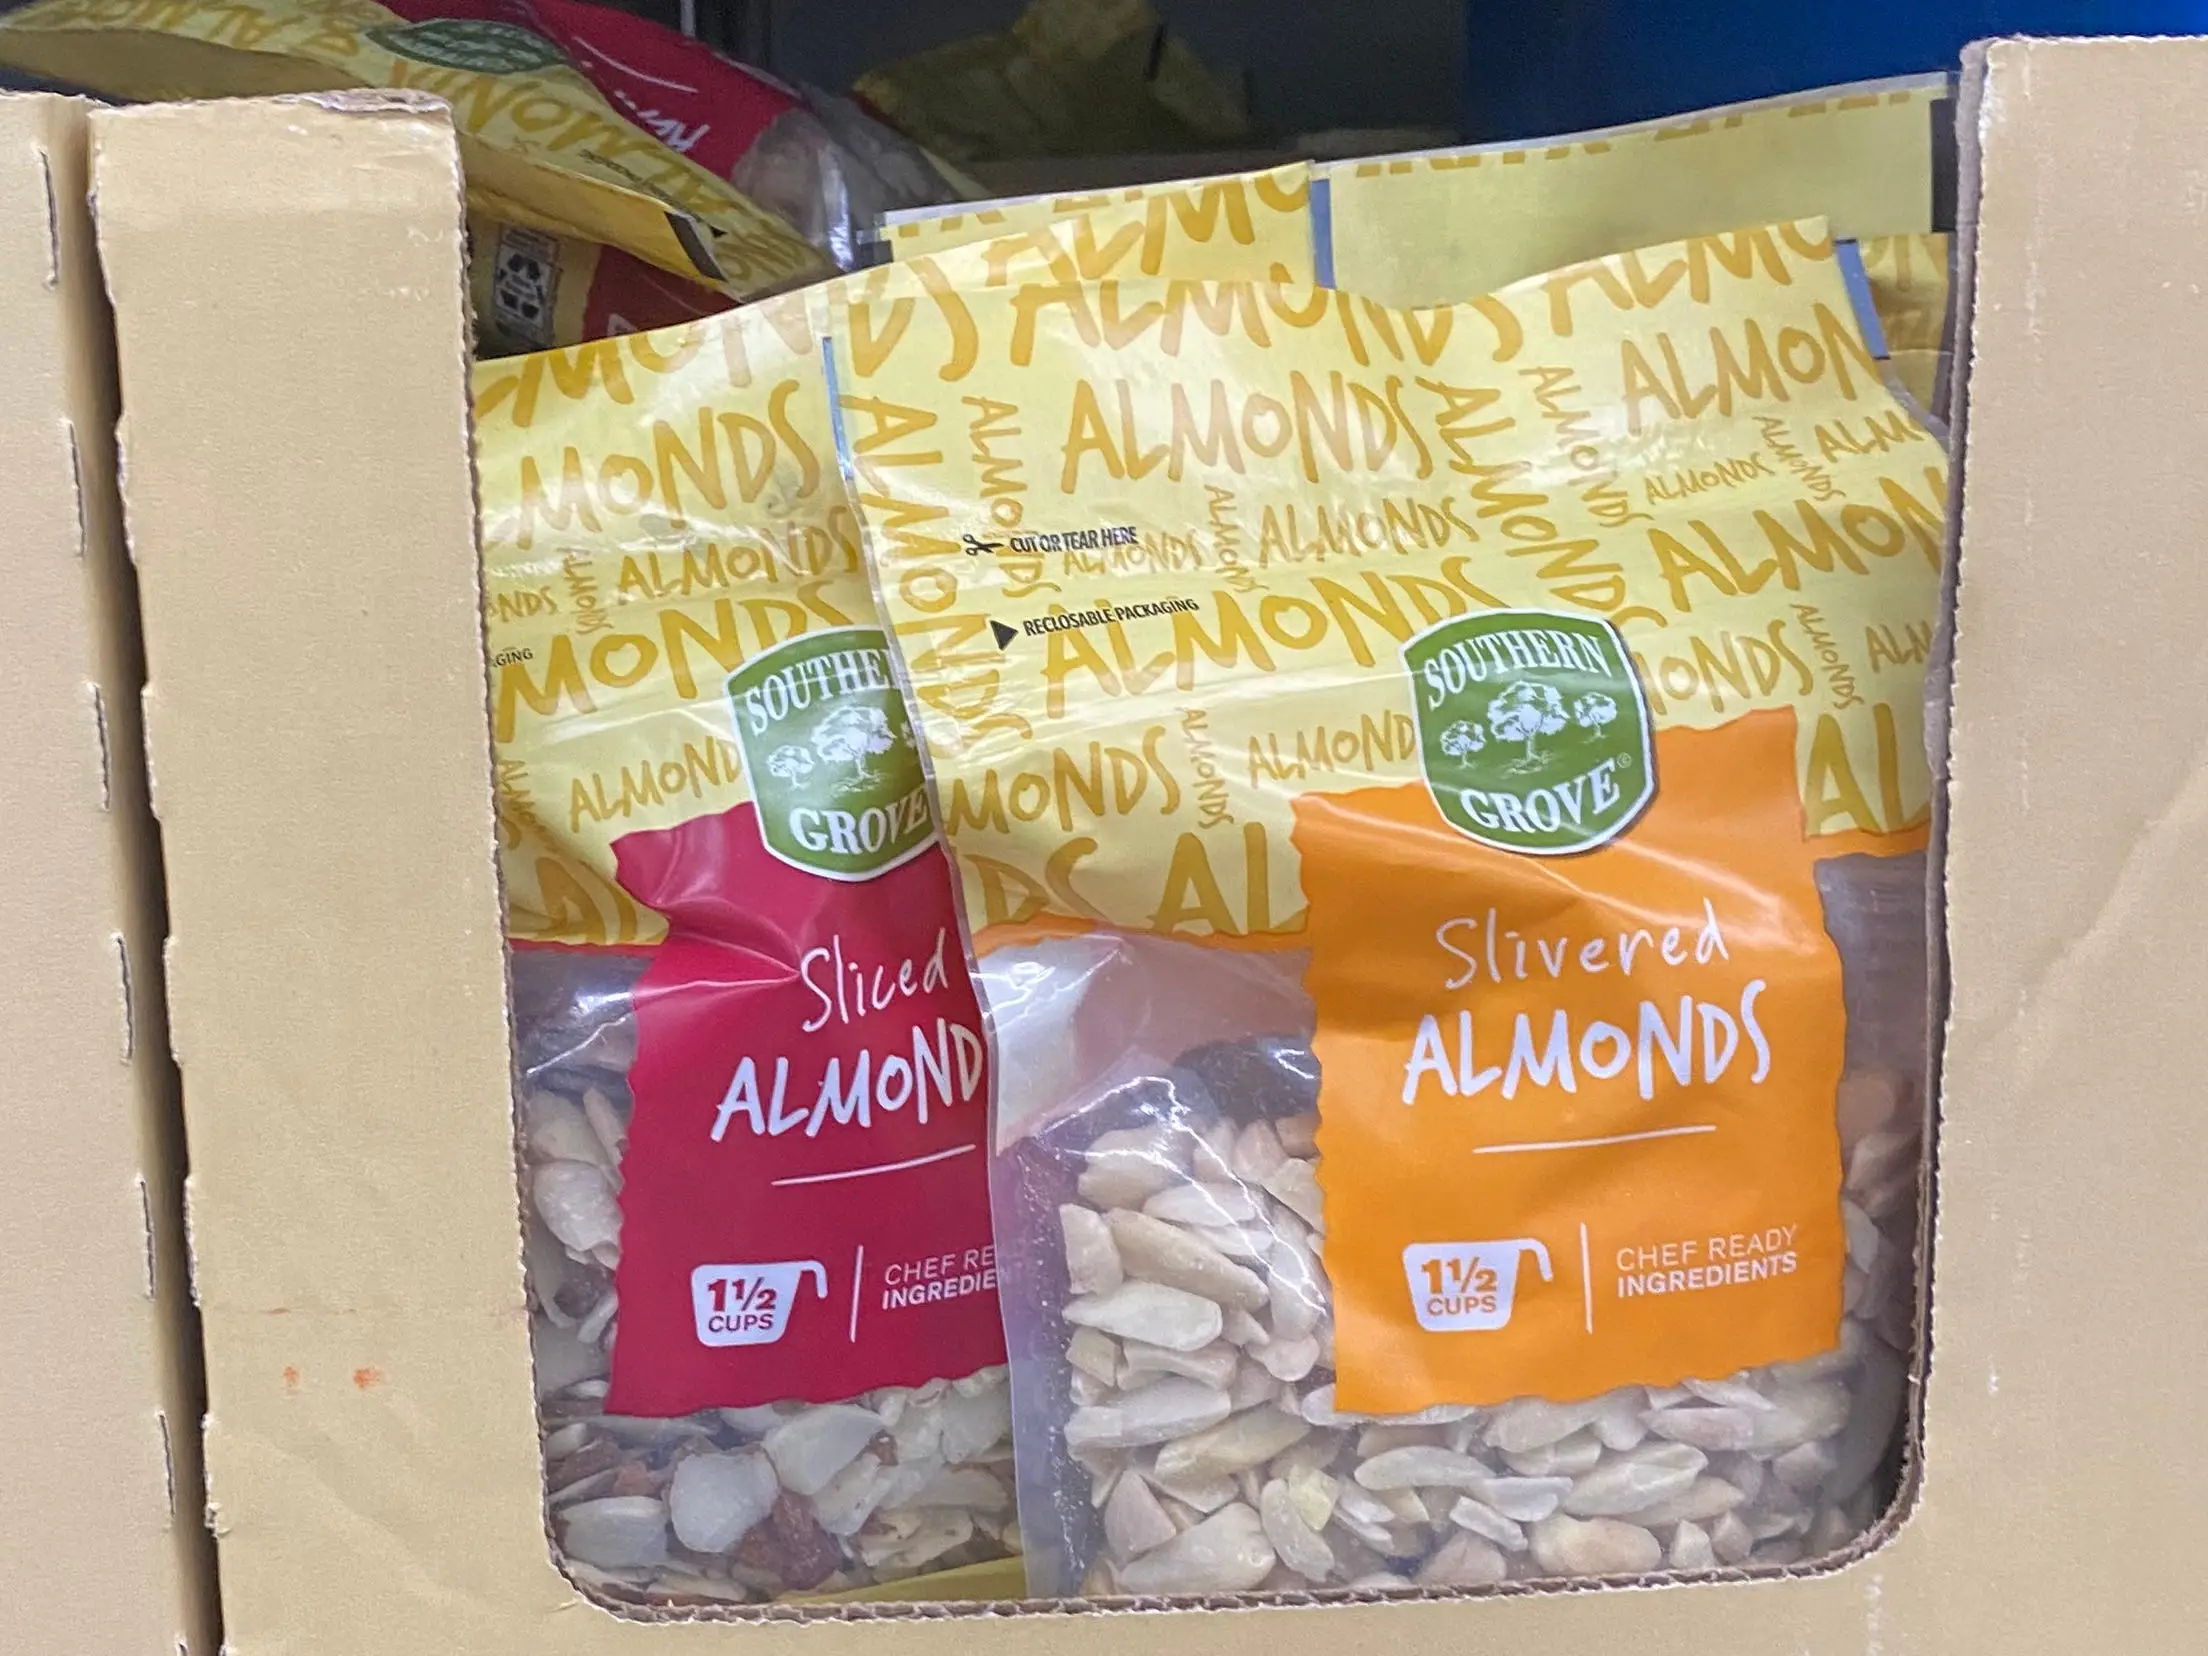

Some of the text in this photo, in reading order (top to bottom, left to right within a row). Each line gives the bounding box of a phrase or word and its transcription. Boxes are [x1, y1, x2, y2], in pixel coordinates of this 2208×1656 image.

[1060, 368, 1435, 494] ALMONDS
[1643, 451, 1776, 505] ALMONDS
[618, 505, 860, 606] ALMONDS
[1010, 526, 1139, 554] CUT OR TEAR HERE
[1258, 497, 1481, 570] ALMONDS
[1022, 598, 1201, 637] RECLOSABLE PACKAGING
[744, 647, 891, 737] SOUTHE
[1423, 629, 1613, 712] SOUTHERN
[1790, 602, 1865, 711] ALMONDS
[788, 786, 929, 856] GROVE
[1460, 756, 1621, 836] GROVE
[1435, 896, 1729, 990] Slivered
[800, 927, 949, 1033] Sliced
[1402, 978, 1772, 1106] ALMONDS
[710, 1017, 984, 1142] ALMOND
[884, 1244, 995, 1286] CHEF RE
[1616, 1224, 1799, 1272] CHEF READY
[1617, 1251, 1798, 1299] INGREDIENTS
[708, 1313, 774, 1333] CUPS
[882, 1268, 997, 1310] INGREDIE
[1427, 1296, 1497, 1317] CUPS
